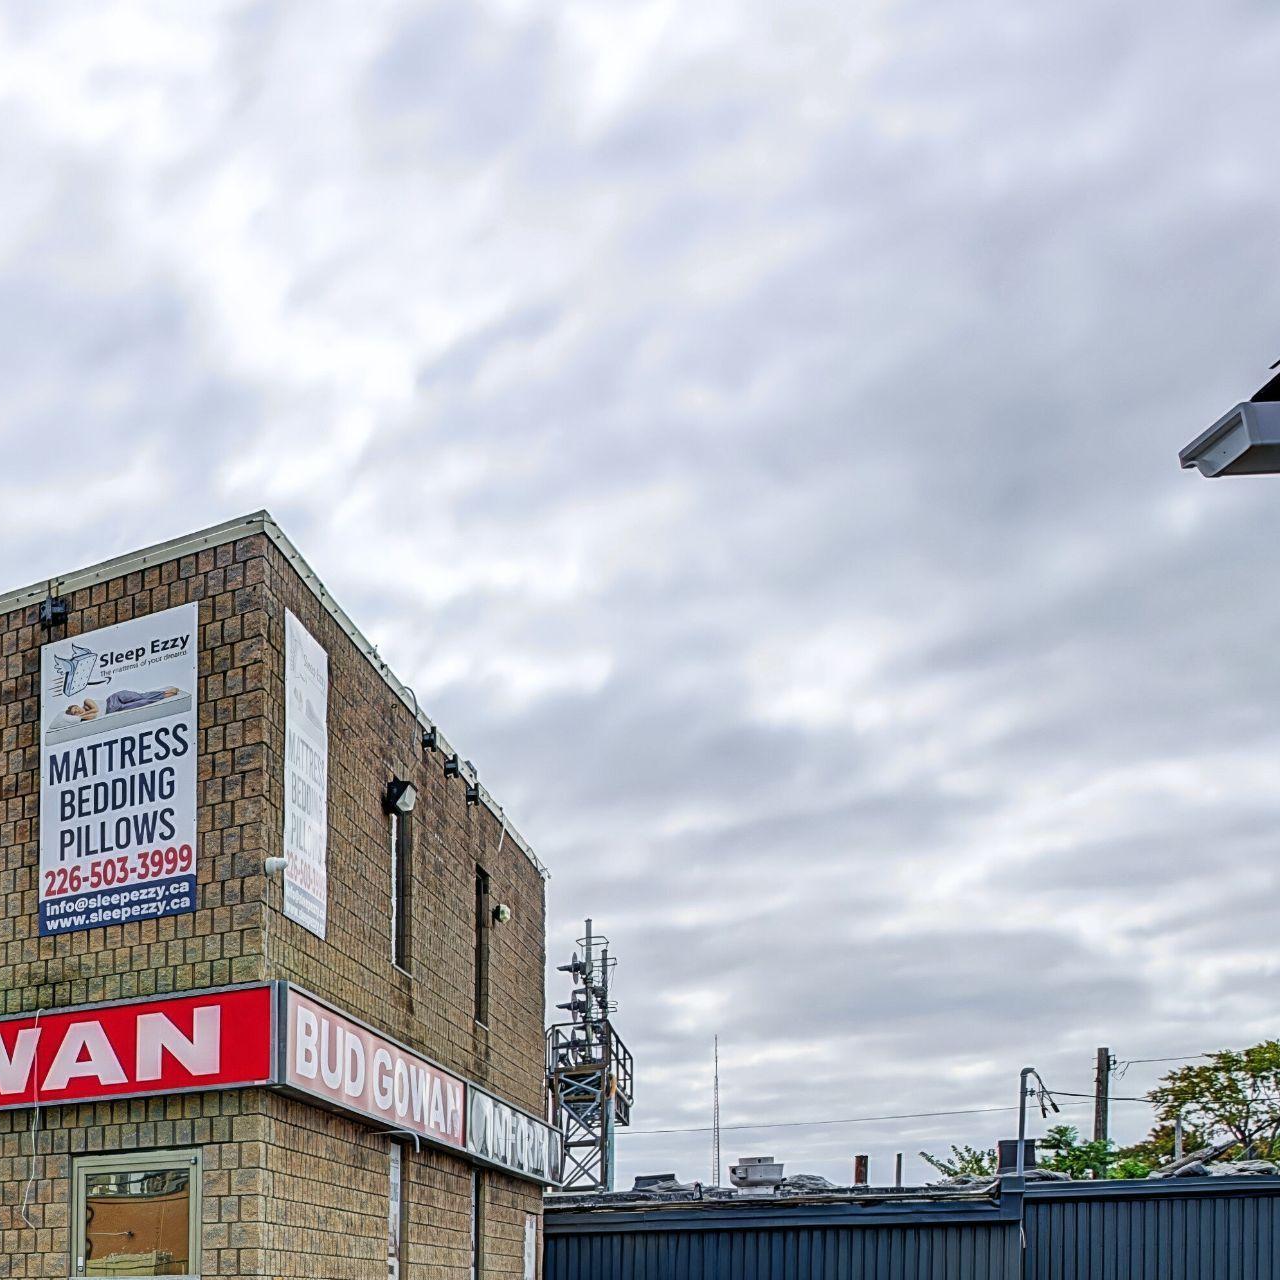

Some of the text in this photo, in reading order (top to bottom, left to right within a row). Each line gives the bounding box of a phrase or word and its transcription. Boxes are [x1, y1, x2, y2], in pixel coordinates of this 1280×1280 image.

[100, 634, 190, 668] Sleep Ezzy
[49, 723, 189, 786] MATTRESS
[60, 766, 175, 822] BEDDING
[60, 808, 176, 861] PILLOWS
[45, 844, 193, 898] 226-503-3999
[46, 880, 190, 917] info@sleepezzy.ca
[46, 896, 190, 932] www.sleepezzy.ca
[296, 1005, 366, 1098] BUD
[372, 1048, 461, 1138] GOWAN
